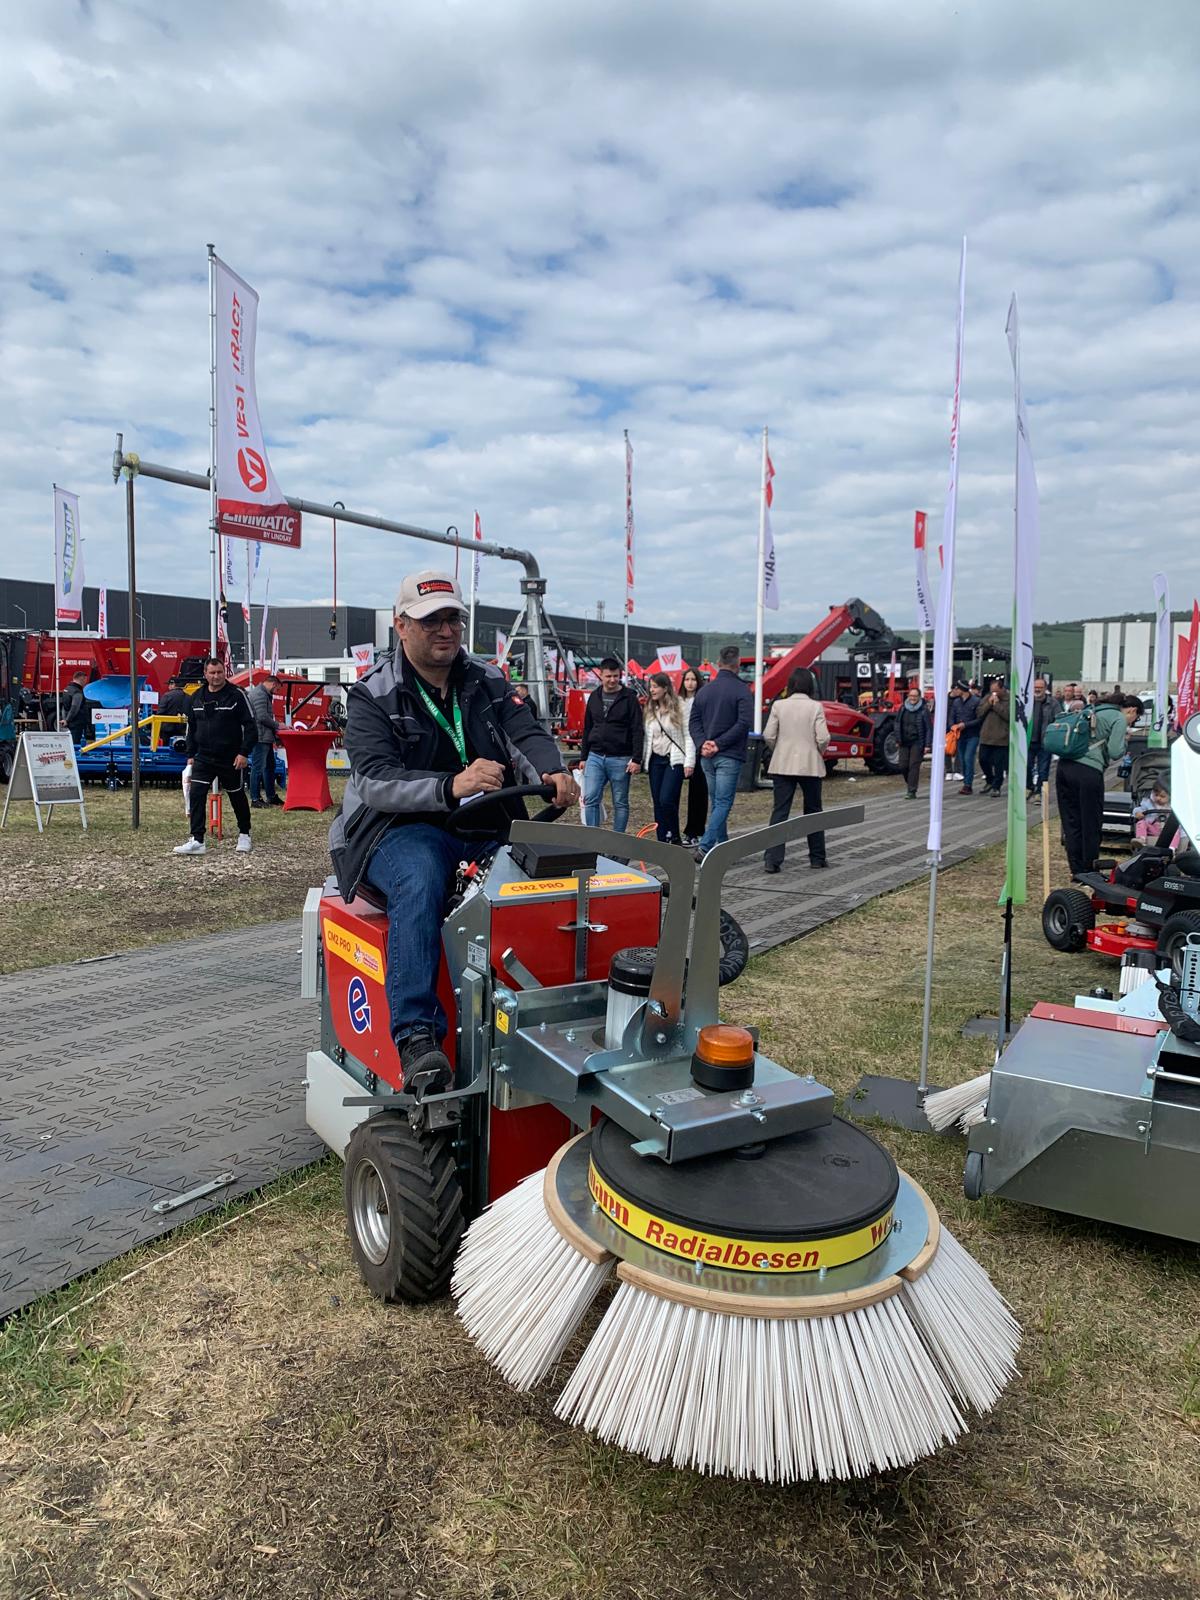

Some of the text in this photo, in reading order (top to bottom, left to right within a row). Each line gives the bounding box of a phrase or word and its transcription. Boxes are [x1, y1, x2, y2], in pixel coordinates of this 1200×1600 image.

[263, 531, 293, 543] BY LINDSAY
[419, 690, 439, 717] AGRARIA
[445, 726, 462, 753] AGRARIA
[510, 881, 565, 893] CM2 PRO
[327, 930, 351, 953] CM2 PRO
[645, 1219, 820, 1270] Radialbesen
